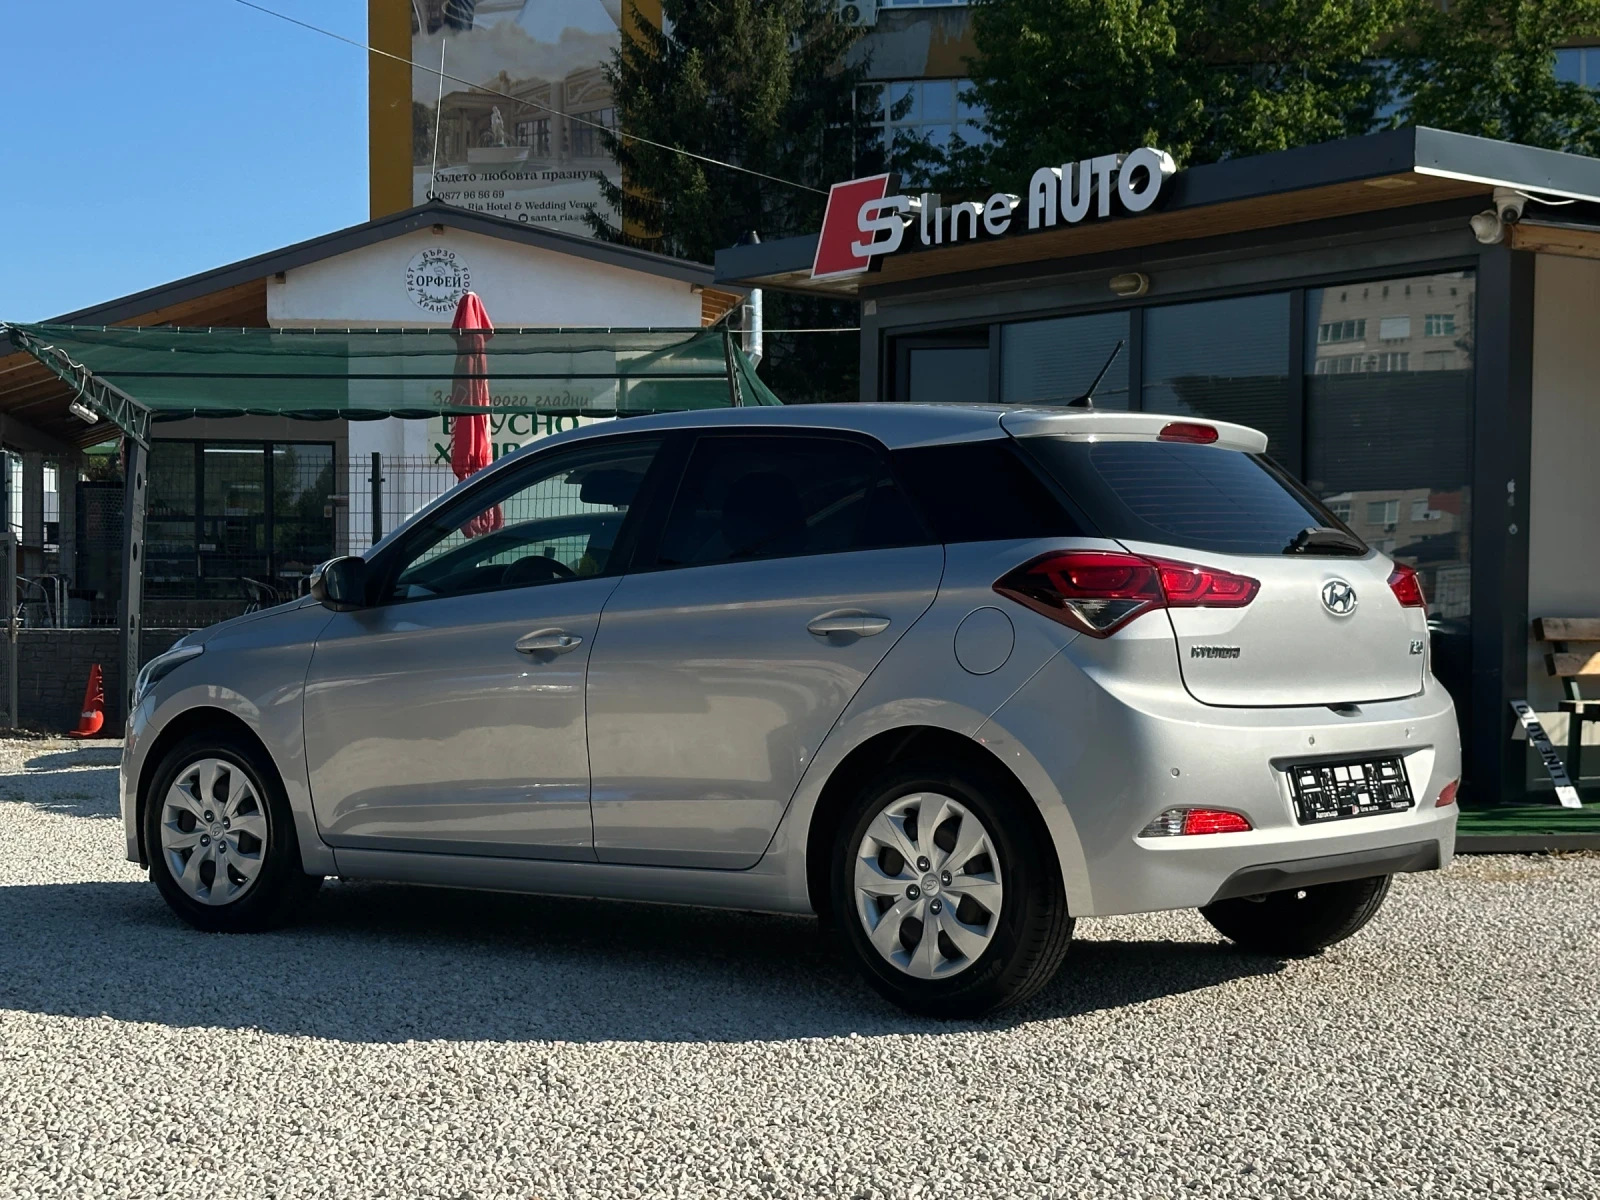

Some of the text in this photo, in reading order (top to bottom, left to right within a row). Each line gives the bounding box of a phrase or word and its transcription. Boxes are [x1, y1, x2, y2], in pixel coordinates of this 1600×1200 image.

[432, 171, 477, 184] Където
[480, 169, 538, 181] любовта
[438, 190, 505, 200] 0877 96 86 69
[1028, 147, 1164, 230] AUTO
[486, 202, 512, 211] Hotel
[514, 202, 523, 210] &
[525, 201, 567, 211] Wedding
[568, 200, 599, 210] Venue
[422, 249, 456, 260] БЪРЗО
[406, 267, 415, 292] FAST
[416, 273, 462, 288] ОРФЕЙ
[461, 267, 471, 295] FOOD
[535, 390, 589, 407] гладни
